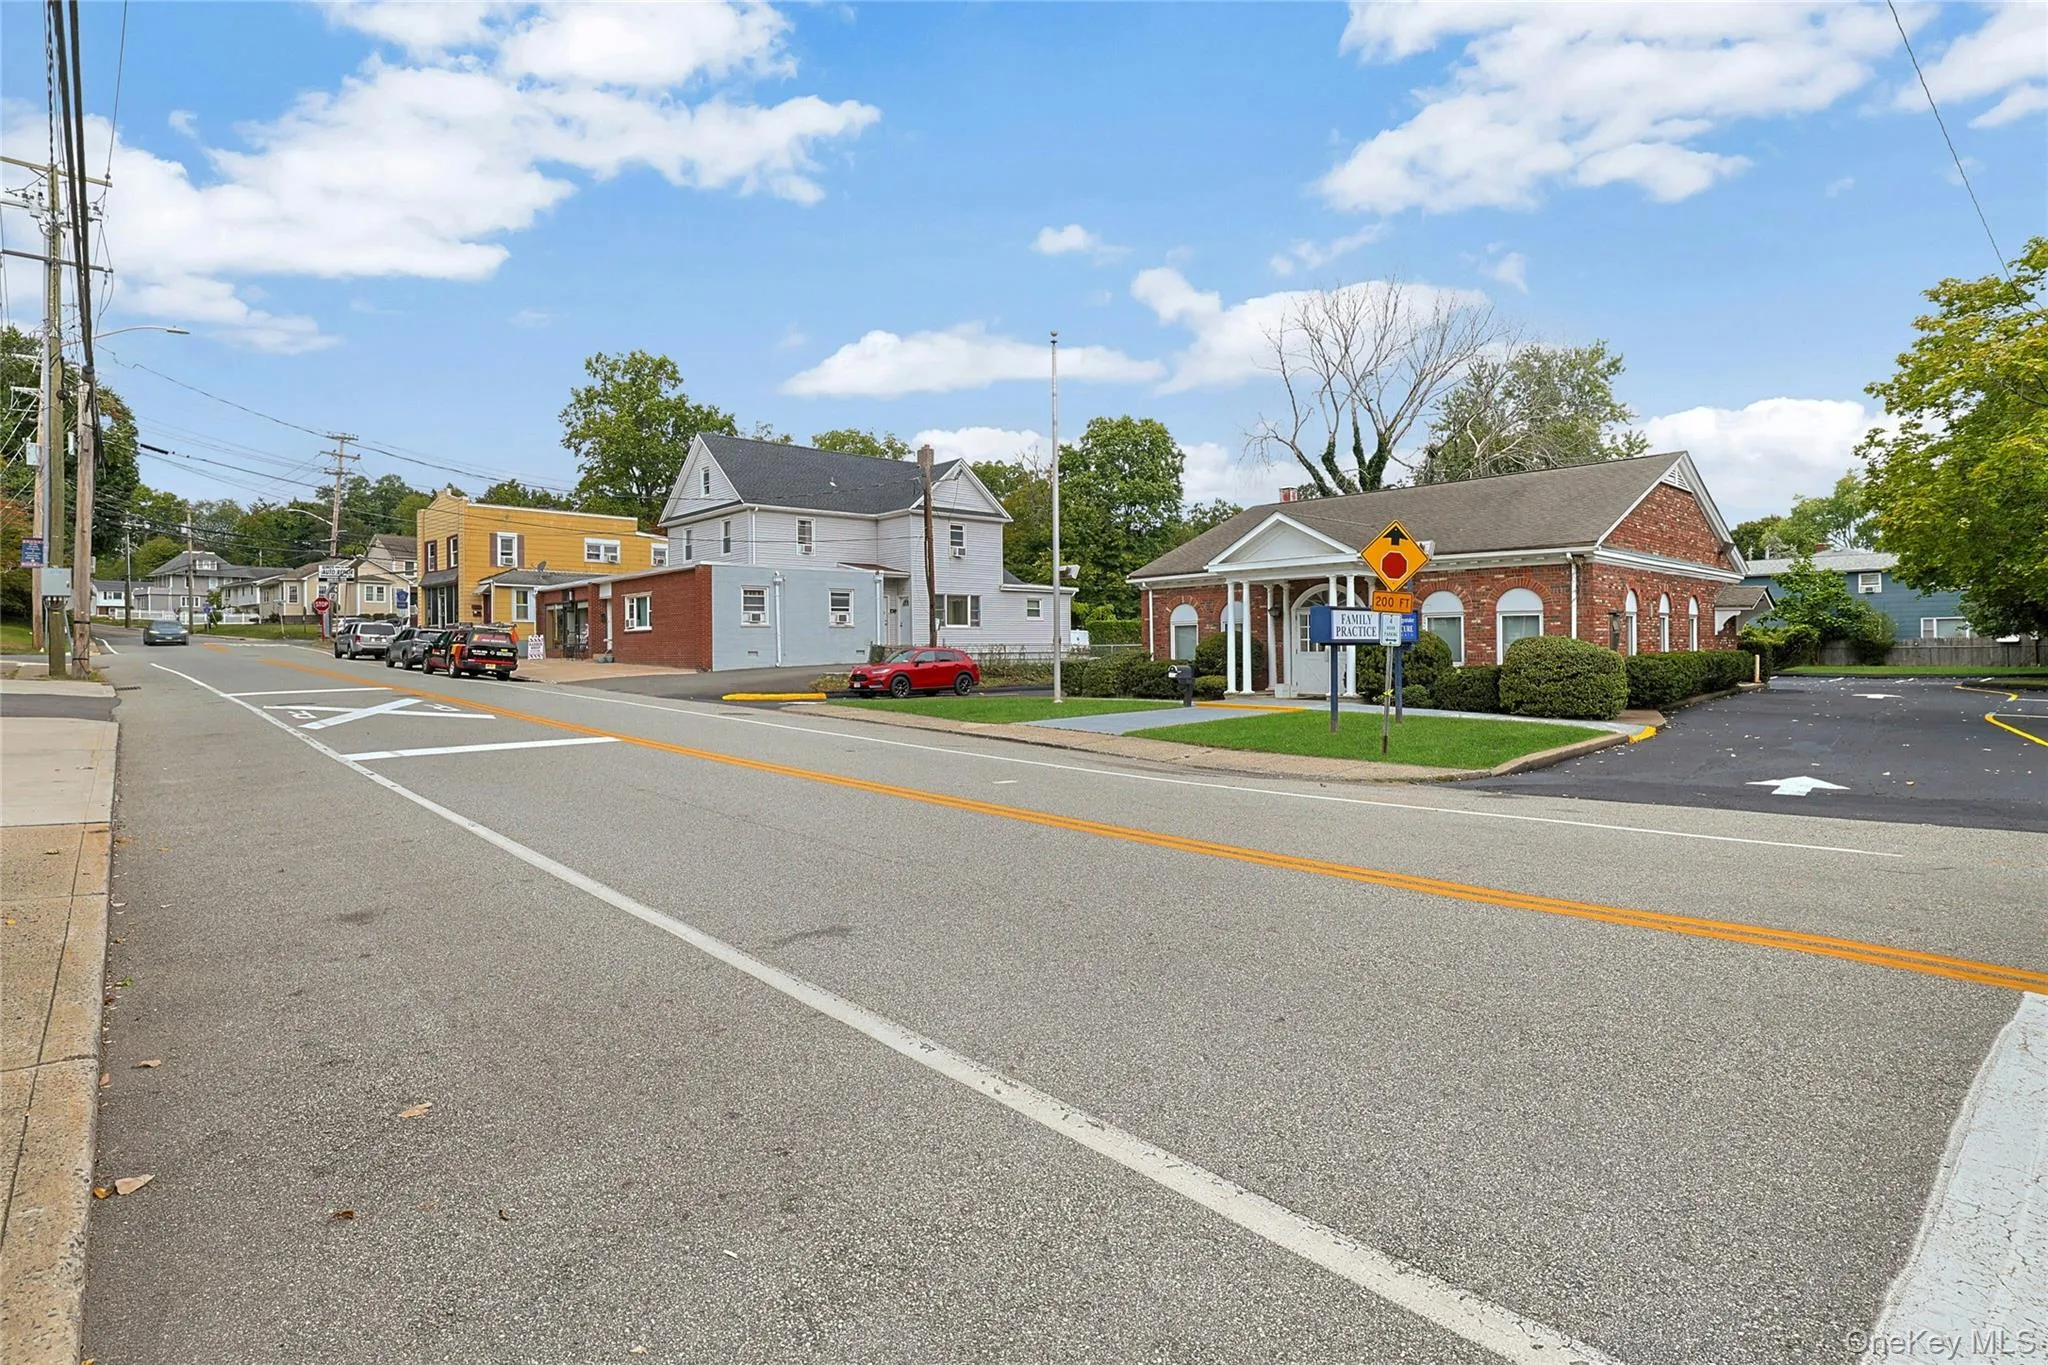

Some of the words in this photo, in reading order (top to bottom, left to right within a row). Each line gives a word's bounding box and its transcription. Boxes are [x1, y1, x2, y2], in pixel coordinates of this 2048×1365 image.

[315, 600, 329, 608] STOP
[1375, 597, 1395, 608] 200
[1399, 598, 1410, 609] FT
[1341, 613, 1373, 625] FAMILY
[1336, 626, 1377, 638] PRACTICE
